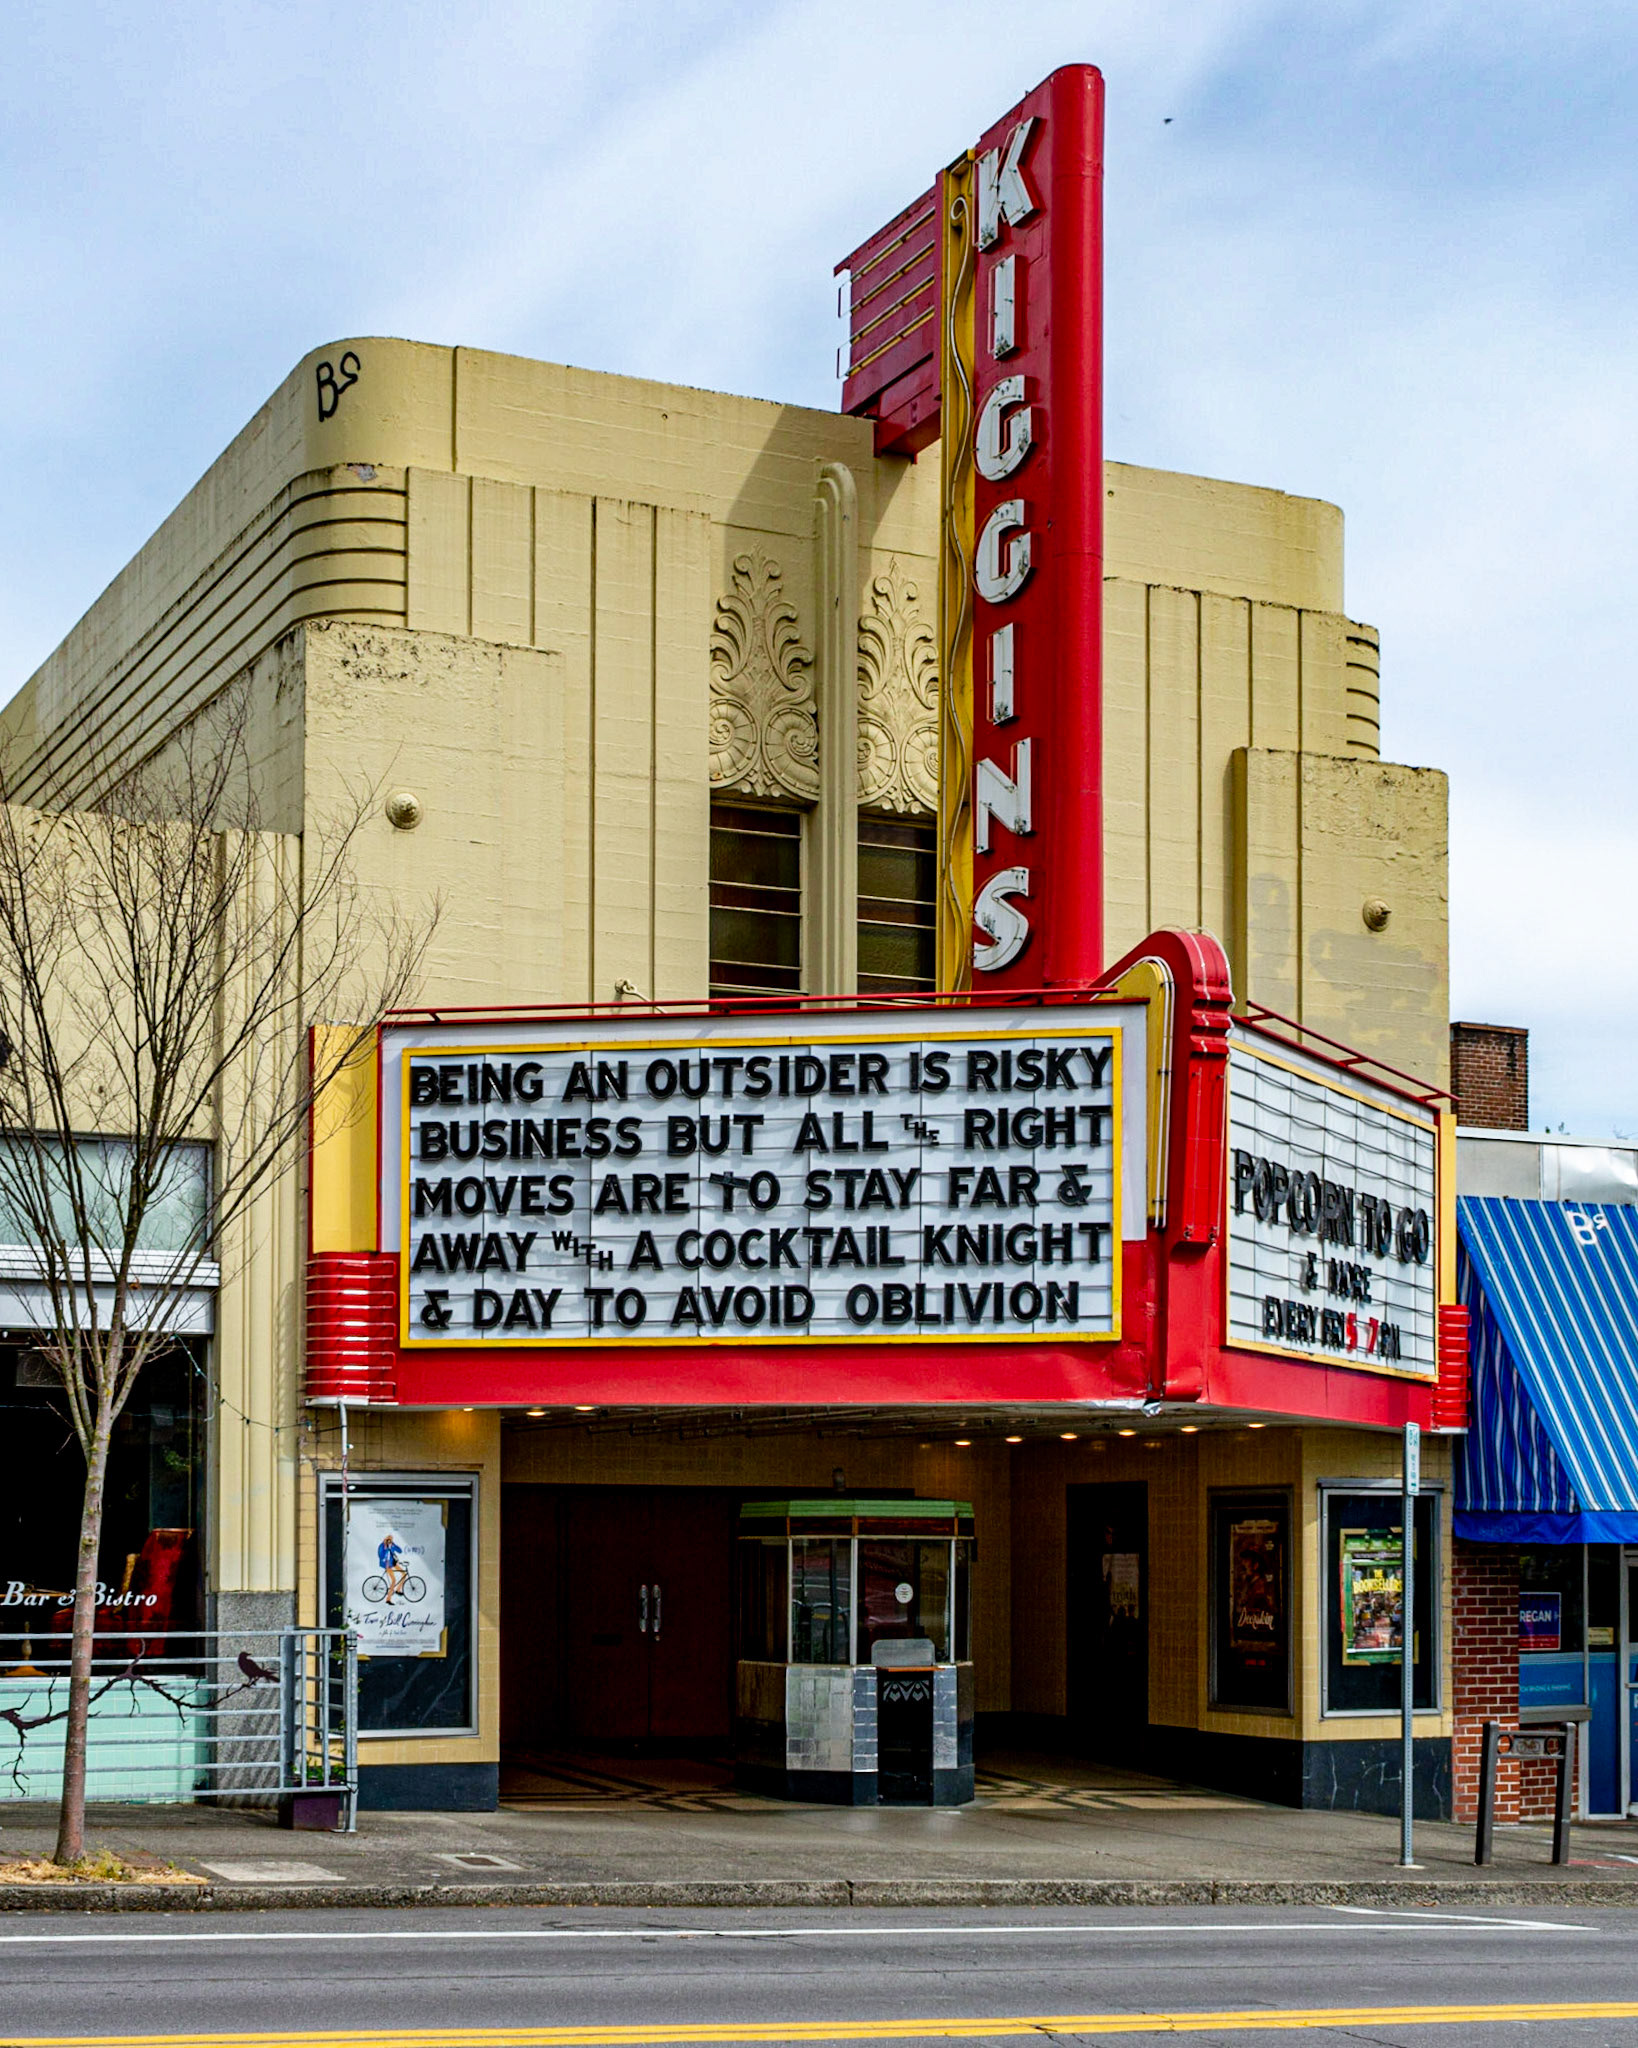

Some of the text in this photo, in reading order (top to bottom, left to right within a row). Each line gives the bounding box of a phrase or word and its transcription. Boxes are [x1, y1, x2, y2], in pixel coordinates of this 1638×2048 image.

[974, 116, 1041, 973] KIGGINS
[410, 1046, 1114, 1106] BEING AN OUTSIDER IS RISKY
[420, 1105, 1112, 1161] BUSINESS BUT ALL THE RIGHT
[414, 1164, 1092, 1217] MOVES ARE TO STAY FAR &
[1235, 1148, 1429, 1264] POPCORN TO GO
[411, 1222, 1111, 1273] AWAY WITH A COCKTAIL KNIGHT
[420, 1281, 1079, 1330] & DAY TO AVOID OBLIVION
[1330, 1257, 1372, 1304] MORE
[1264, 1295, 1318, 1344] EVERY
[1321, 1307, 1345, 1349] FRI
[1, 1581, 157, 1606] Bar & Bistro
